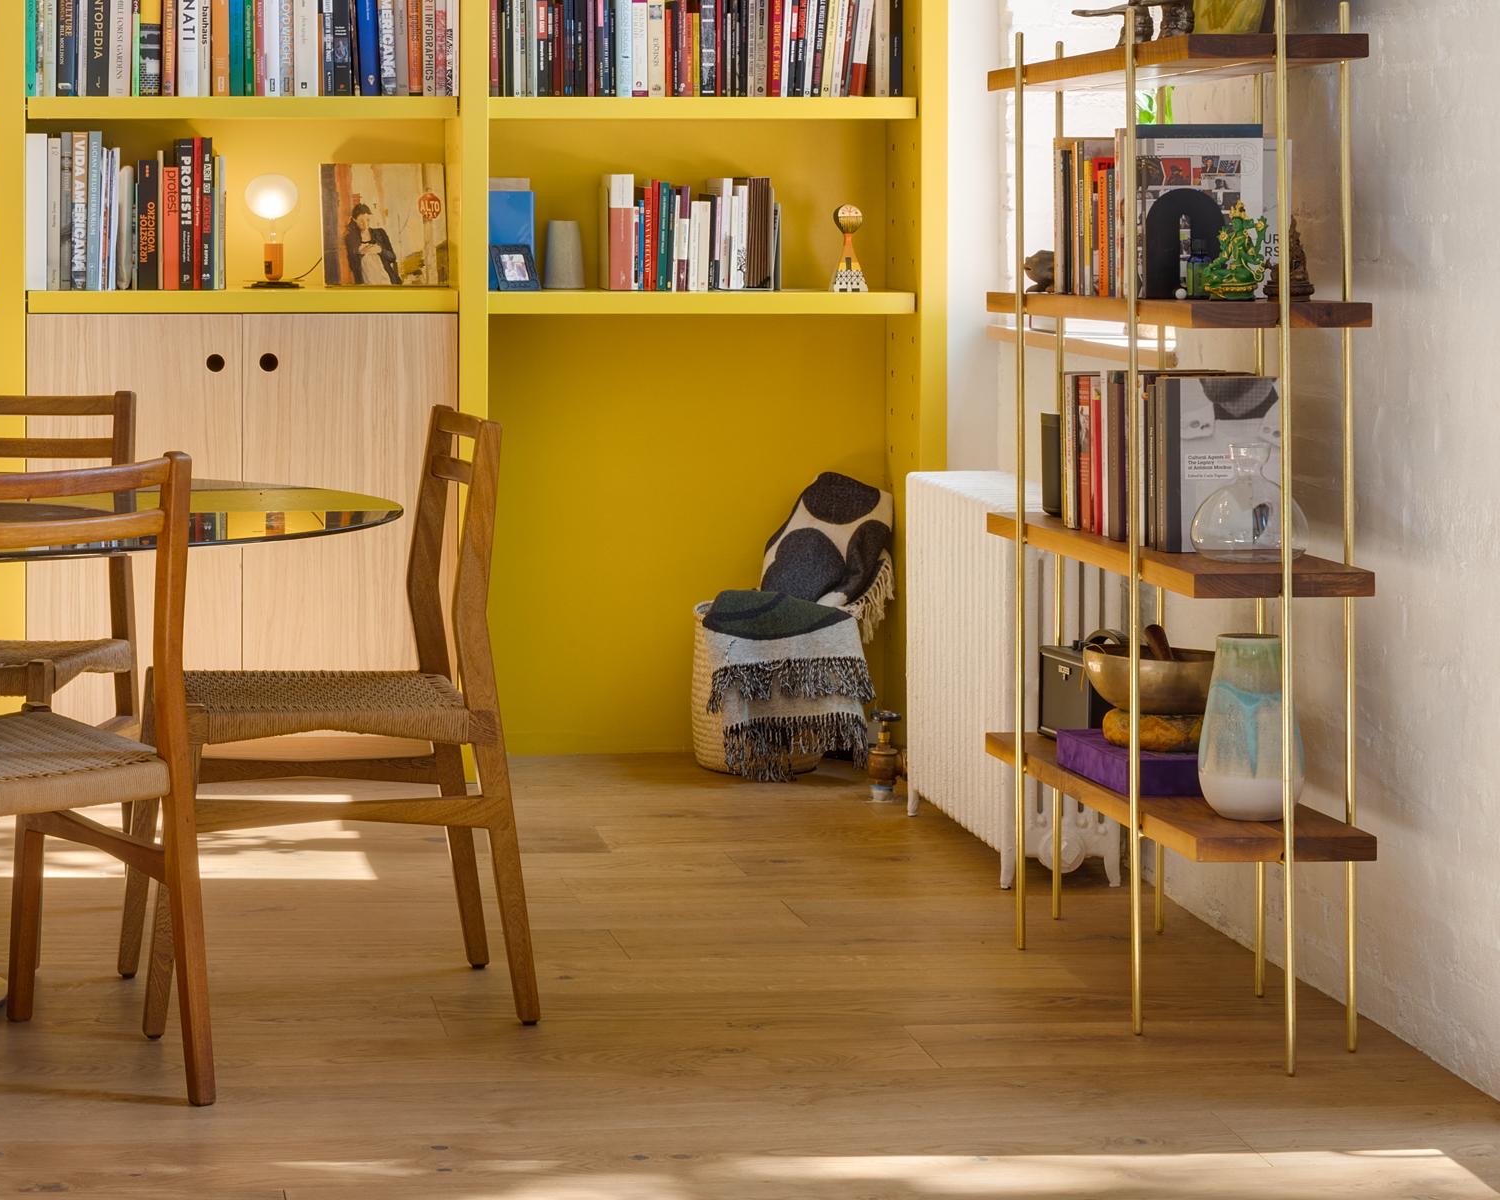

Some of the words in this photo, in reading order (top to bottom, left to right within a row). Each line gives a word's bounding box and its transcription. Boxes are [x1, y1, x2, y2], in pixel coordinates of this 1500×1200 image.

[282, 26, 290, 64] WRIGHT
[425, 14, 433, 80] INFOGRAPHICS
[74, 141, 84, 180] VIDA
[164, 170, 177, 216] protest.
[181, 156, 191, 225] PROTEST!
[74, 182, 84, 270] AMERICANA
